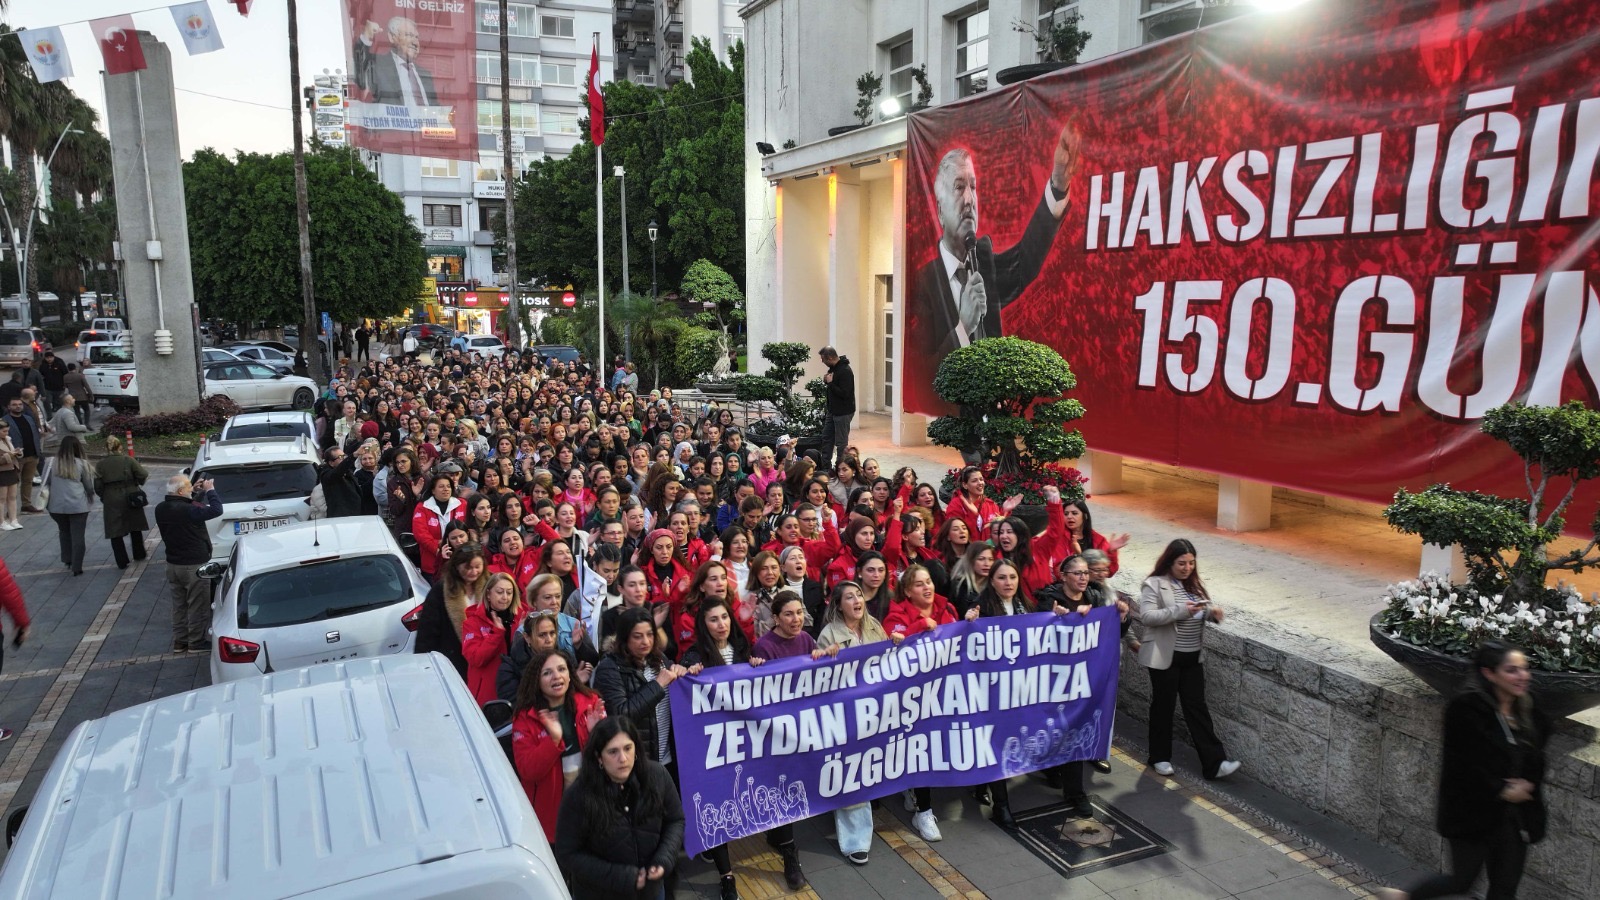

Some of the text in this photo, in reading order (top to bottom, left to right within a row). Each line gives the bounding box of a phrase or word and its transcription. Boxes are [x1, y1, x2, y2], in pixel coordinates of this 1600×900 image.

[386, 106, 410, 117] ADANA
[254, 521, 269, 531] ABU
[692, 620, 1101, 715] KADINLARIN GÜCÜNE GÜÇ KATAN
[704, 661, 1093, 770] ZEYDAN BAŞKAN'IMIZA
[818, 721, 998, 798] ÖZGÜRLÜK
